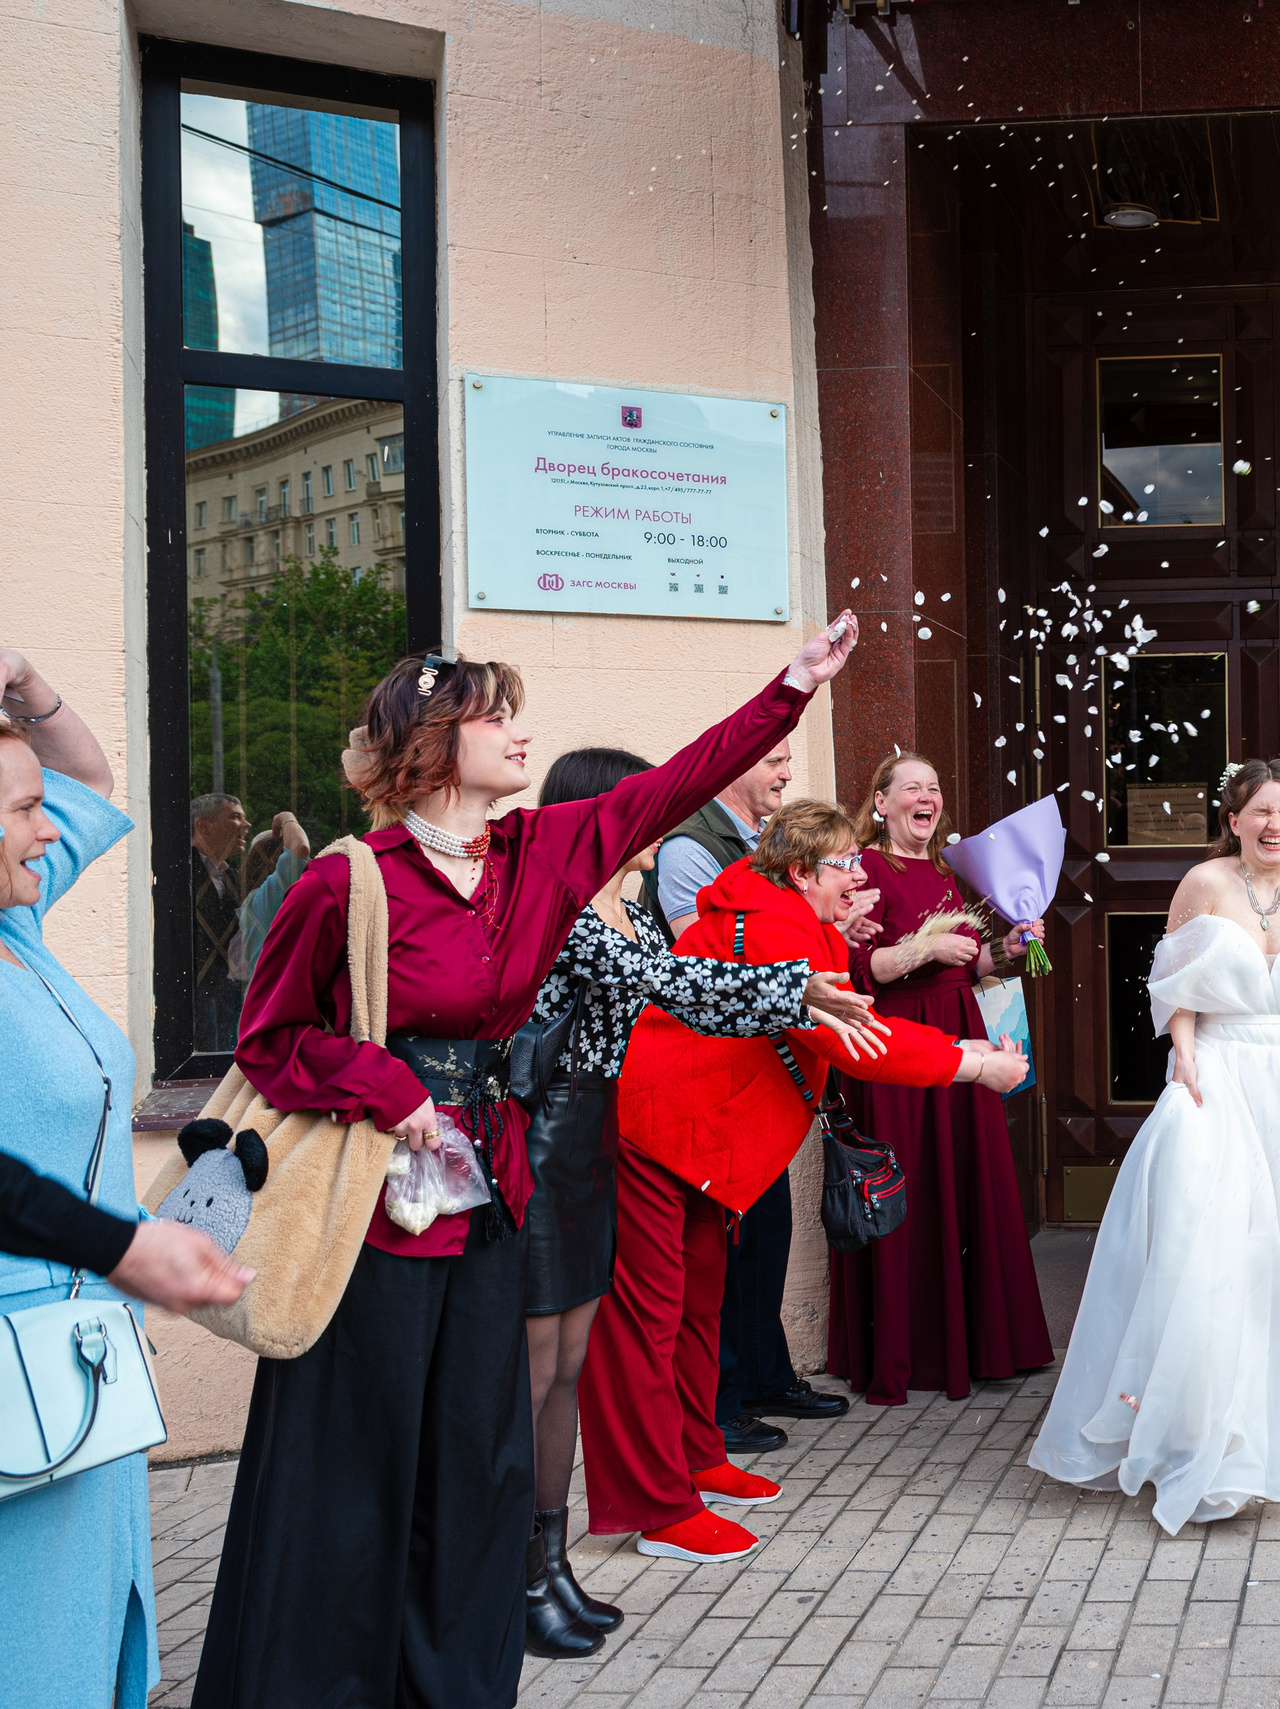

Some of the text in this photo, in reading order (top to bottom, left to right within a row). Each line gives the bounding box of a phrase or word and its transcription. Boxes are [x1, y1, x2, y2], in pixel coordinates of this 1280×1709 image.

[633, 438, 678, 448] ГРАЖДАНСКОГО
[535, 457, 726, 486] Дворец бракосочетания
[575, 505, 691, 524] РЕЖИМ РАБОТЫ
[644, 532, 675, 545] 9:00
[691, 535, 727, 548] 18:00
[595, 581, 636, 589] МОСКВЫ
